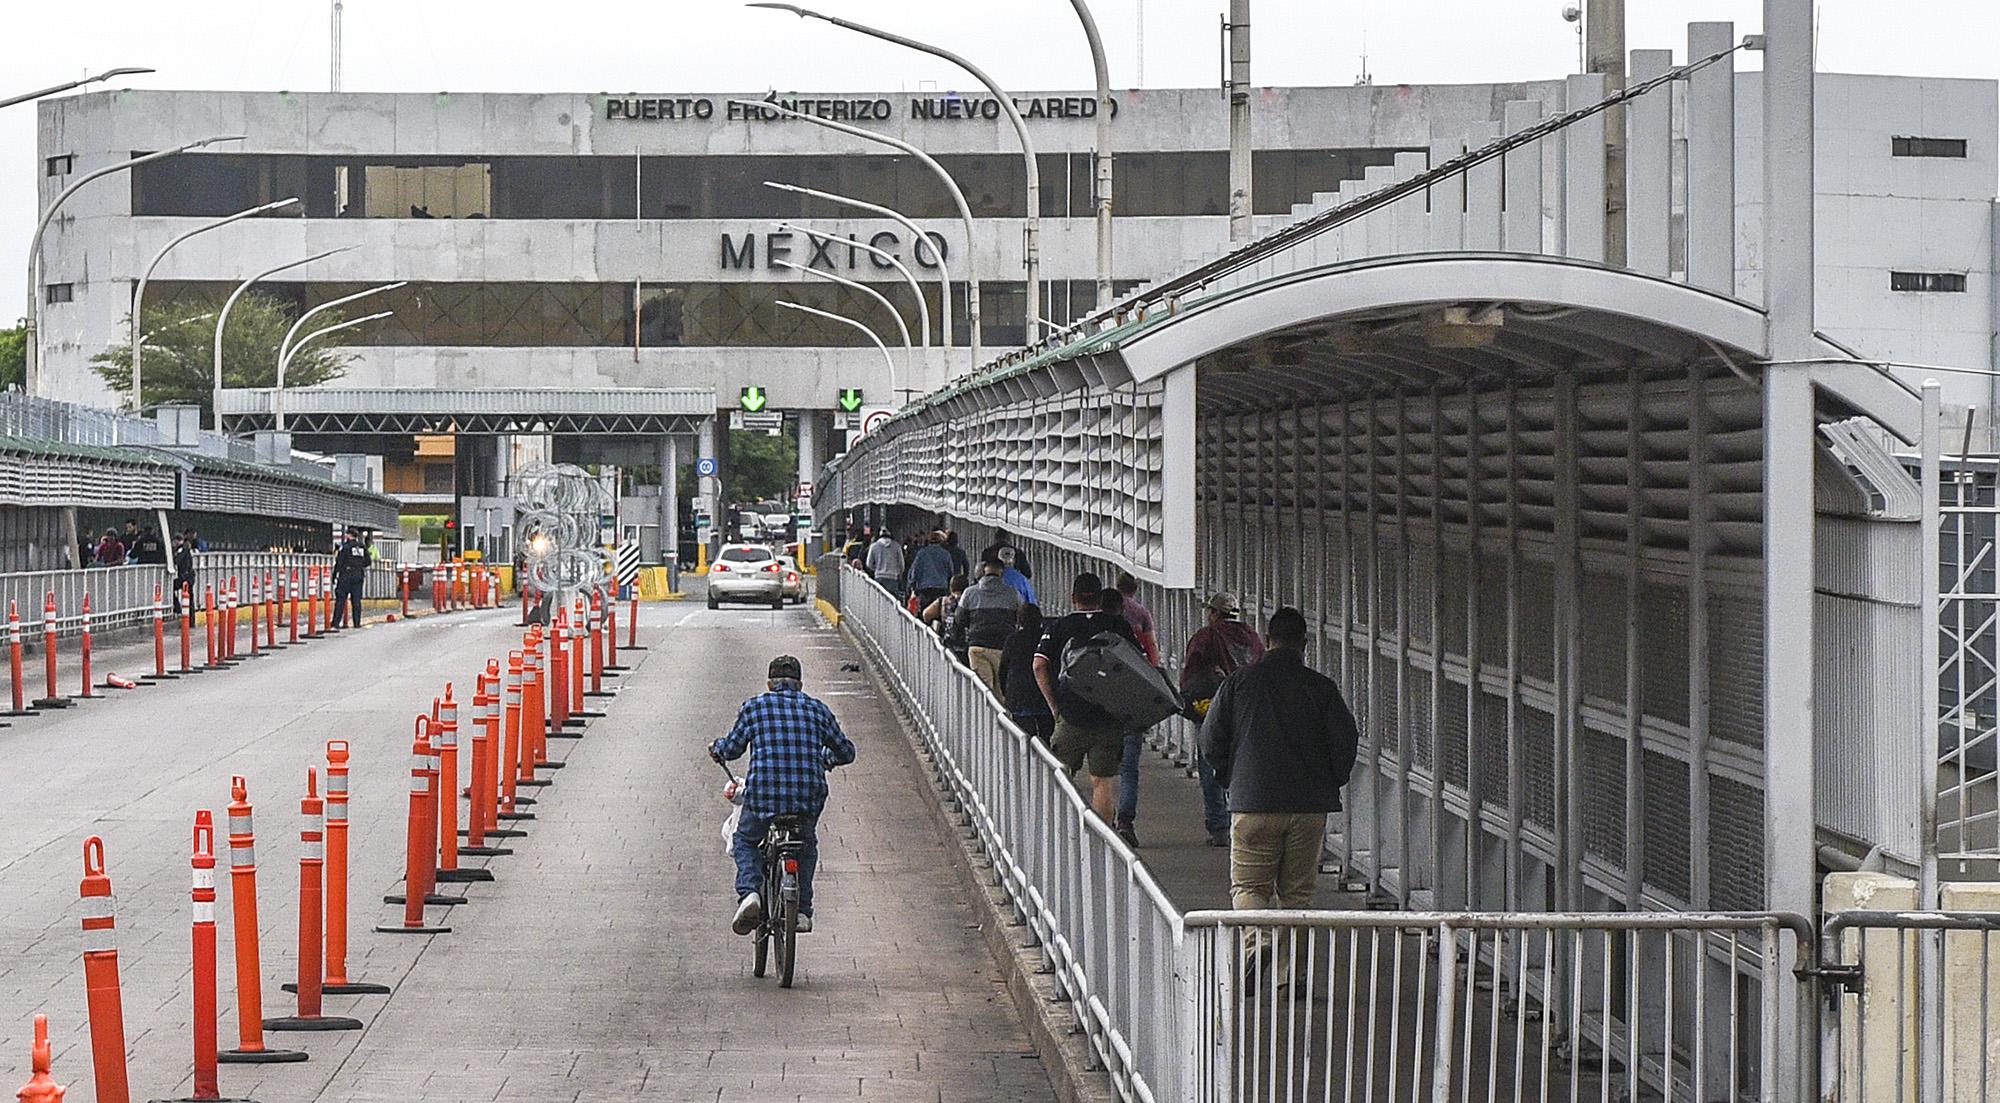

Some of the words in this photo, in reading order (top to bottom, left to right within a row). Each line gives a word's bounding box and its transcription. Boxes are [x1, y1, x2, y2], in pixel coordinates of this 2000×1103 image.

[606, 98, 714, 120] PUERTO
[727, 98, 892, 121] FRONTERIZO
[911, 98, 1000, 120] NUEVO
